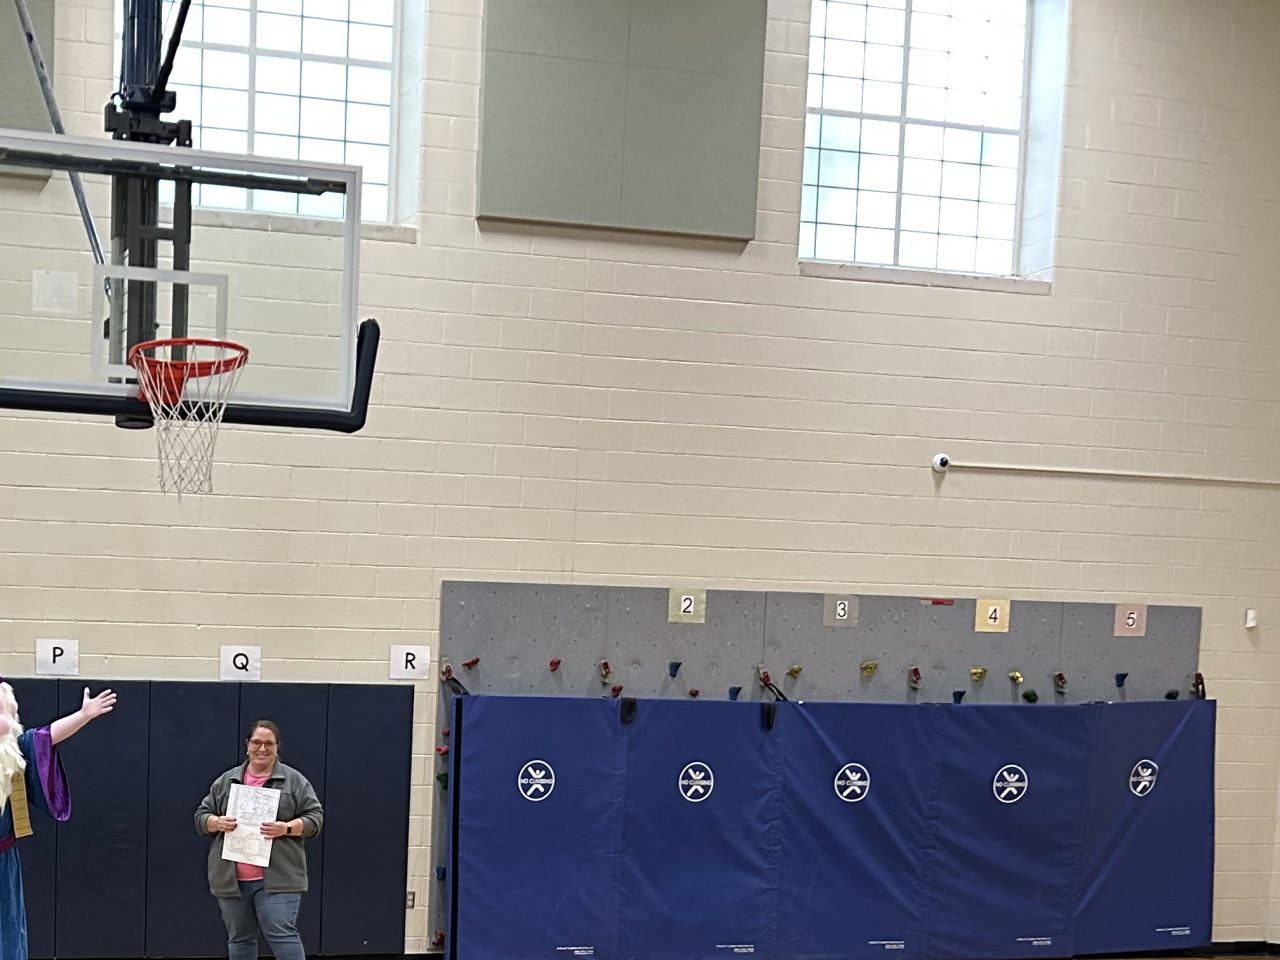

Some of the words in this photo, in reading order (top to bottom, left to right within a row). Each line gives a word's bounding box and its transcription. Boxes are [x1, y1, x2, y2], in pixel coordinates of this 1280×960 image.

[682, 597, 693, 614] 2
[837, 601, 847, 617] 3
[988, 608, 999, 623] 4
[1126, 612, 1136, 627] 5
[52, 646, 64, 664] P
[232, 652, 249, 672] Q
[404, 652, 416, 670] R
